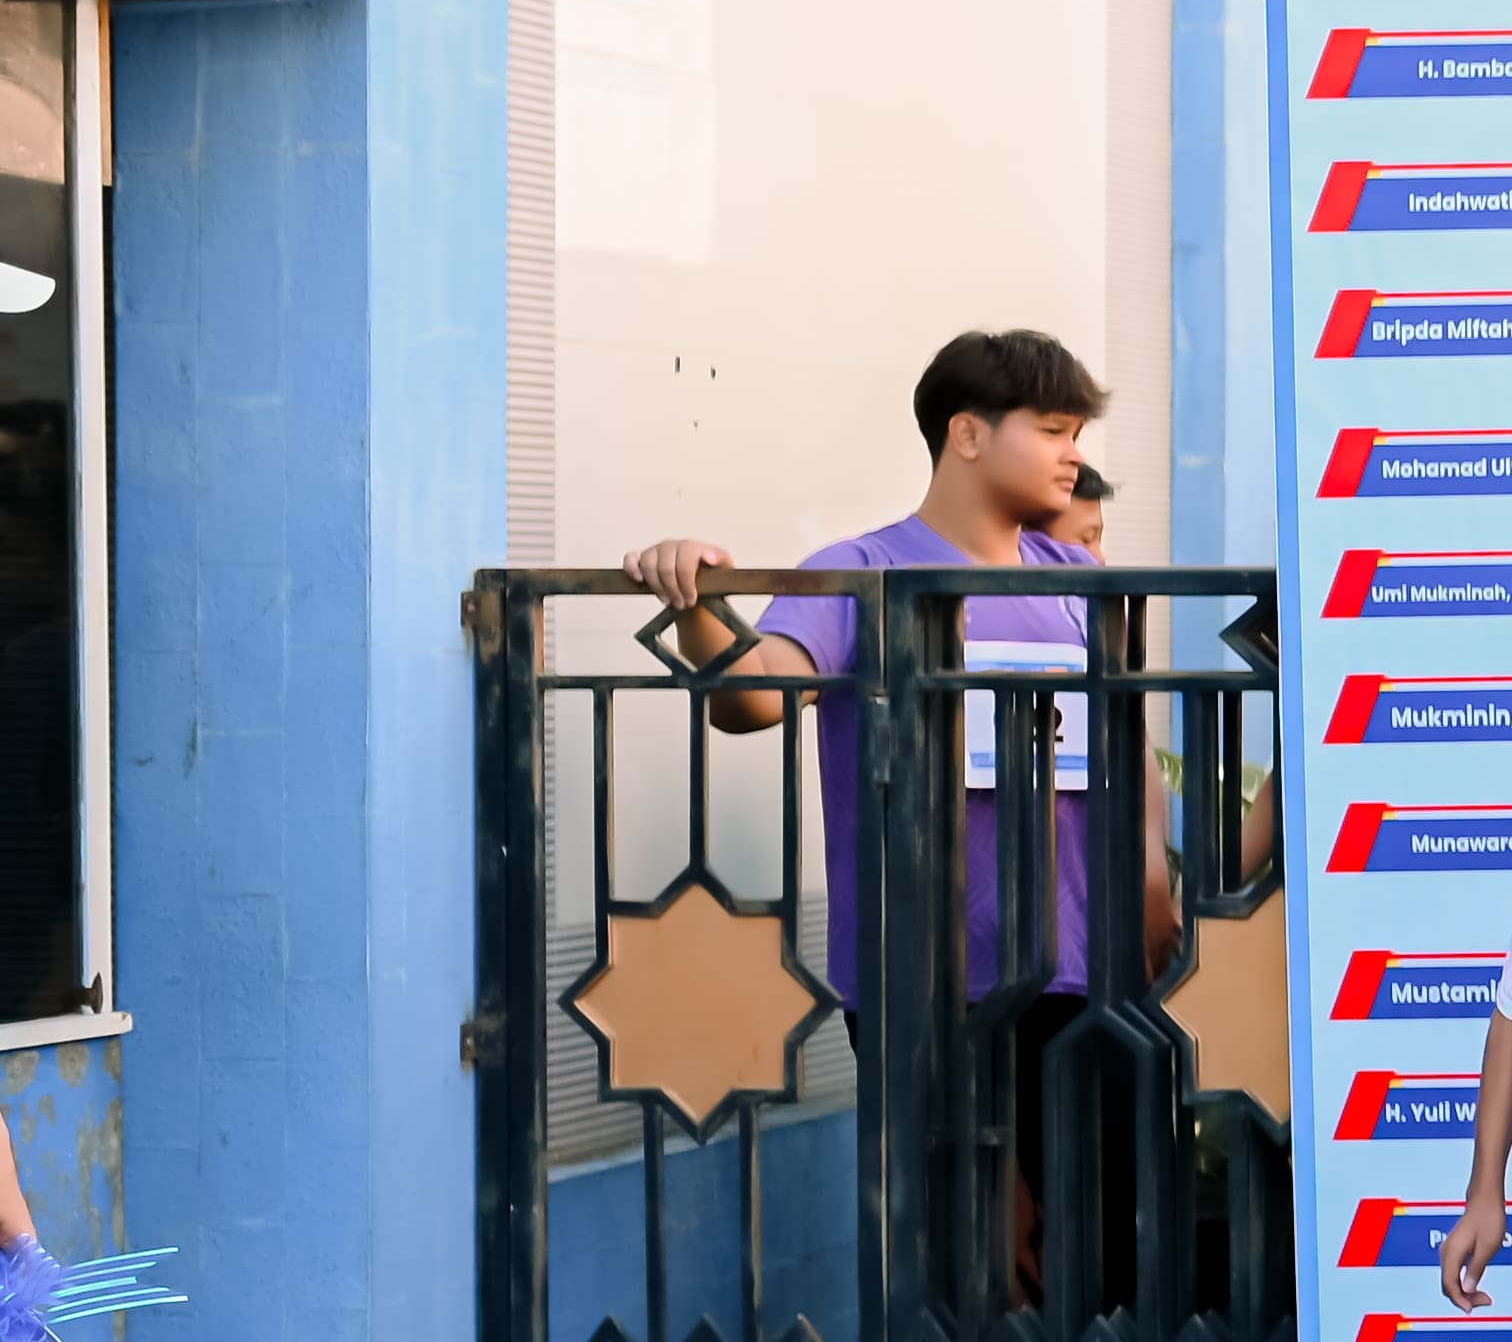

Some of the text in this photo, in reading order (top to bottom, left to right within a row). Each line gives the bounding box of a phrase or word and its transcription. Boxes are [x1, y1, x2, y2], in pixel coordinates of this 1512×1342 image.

[1418, 60, 1439, 80] H.
[1371, 320, 1443, 344] Bripda
[1382, 457, 1487, 479] Mohamad
[1371, 584, 1407, 602] Umi
[1410, 583, 1511, 604] Mukminah,
[1392, 982, 1497, 1004] Mustami
[1386, 1103, 1406, 1123] H.
